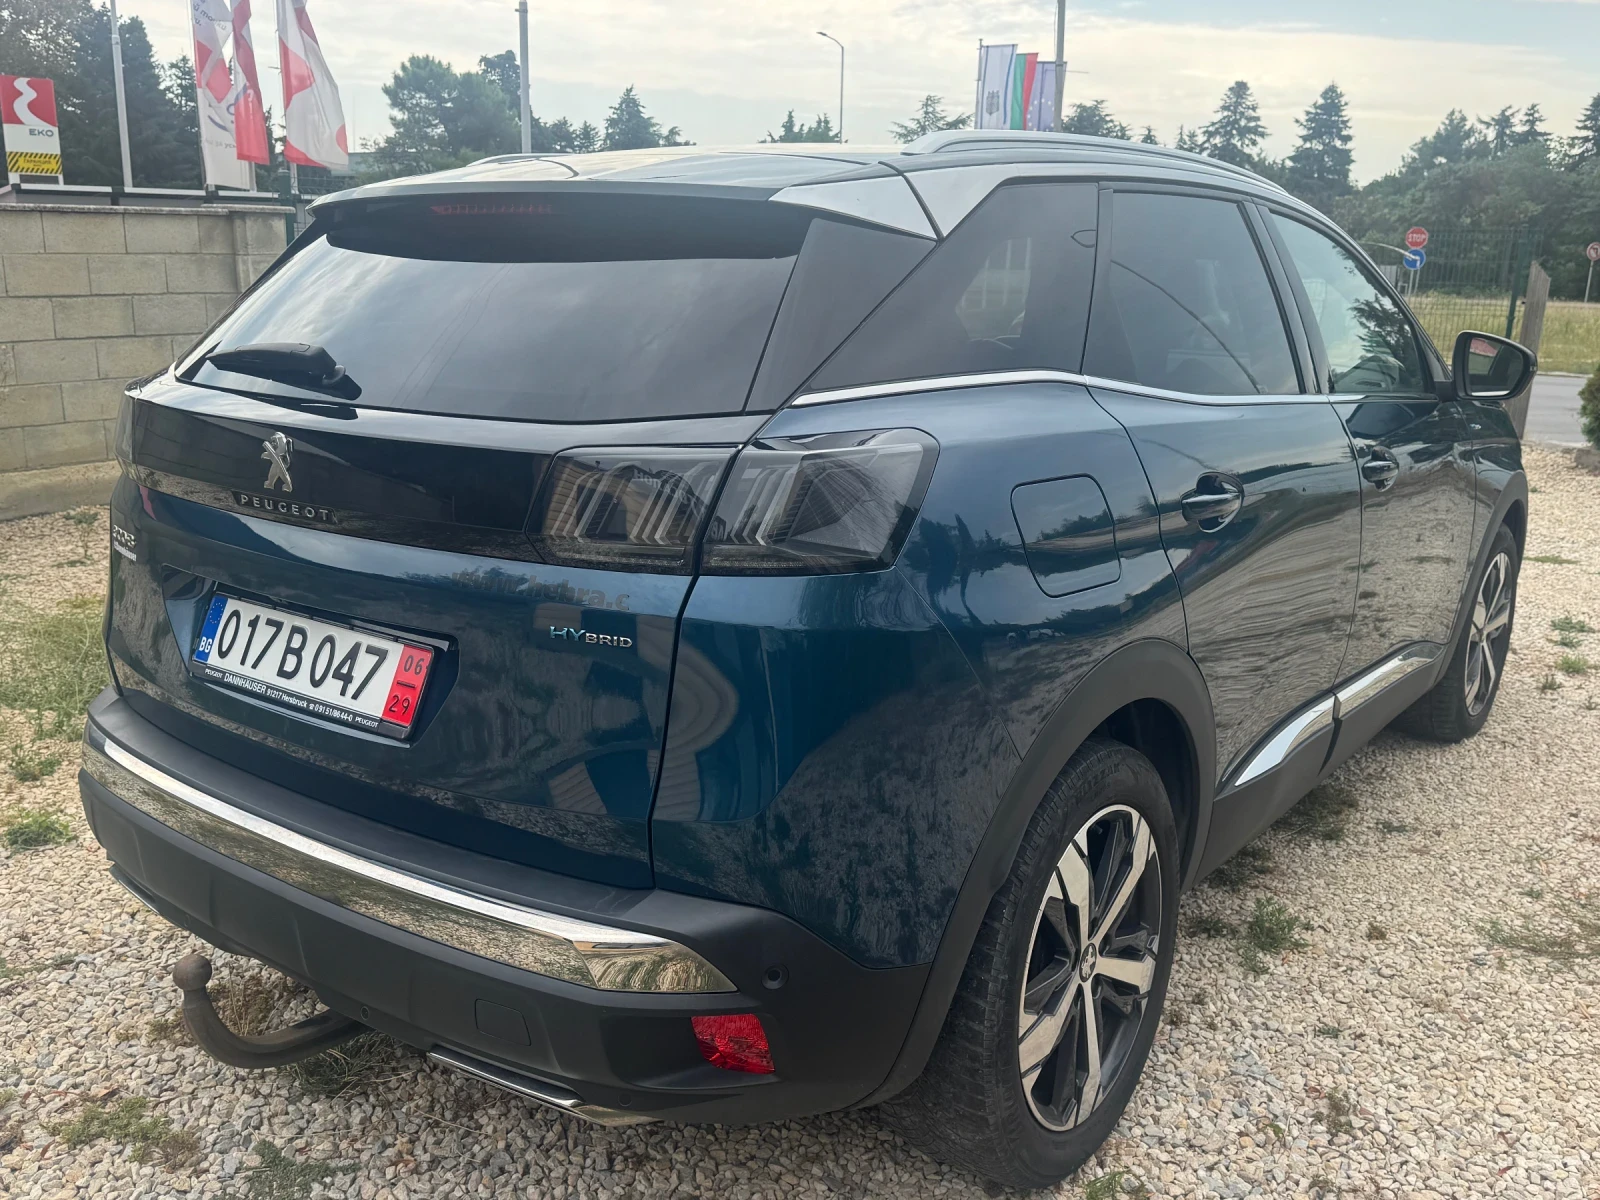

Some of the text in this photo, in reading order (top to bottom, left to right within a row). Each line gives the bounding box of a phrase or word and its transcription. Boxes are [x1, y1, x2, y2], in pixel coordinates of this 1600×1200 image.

[29, 128, 54, 138] EKO
[1408, 233, 1426, 242] STOP
[240, 494, 328, 520] PEUGEOT
[199, 636, 212, 653] BG
[549, 625, 632, 648] HYBRID
[217, 609, 388, 700] 017B047
[403, 654, 425, 675] 06
[388, 693, 411, 716] 29
[355, 716, 379, 728] PEUGEOT
